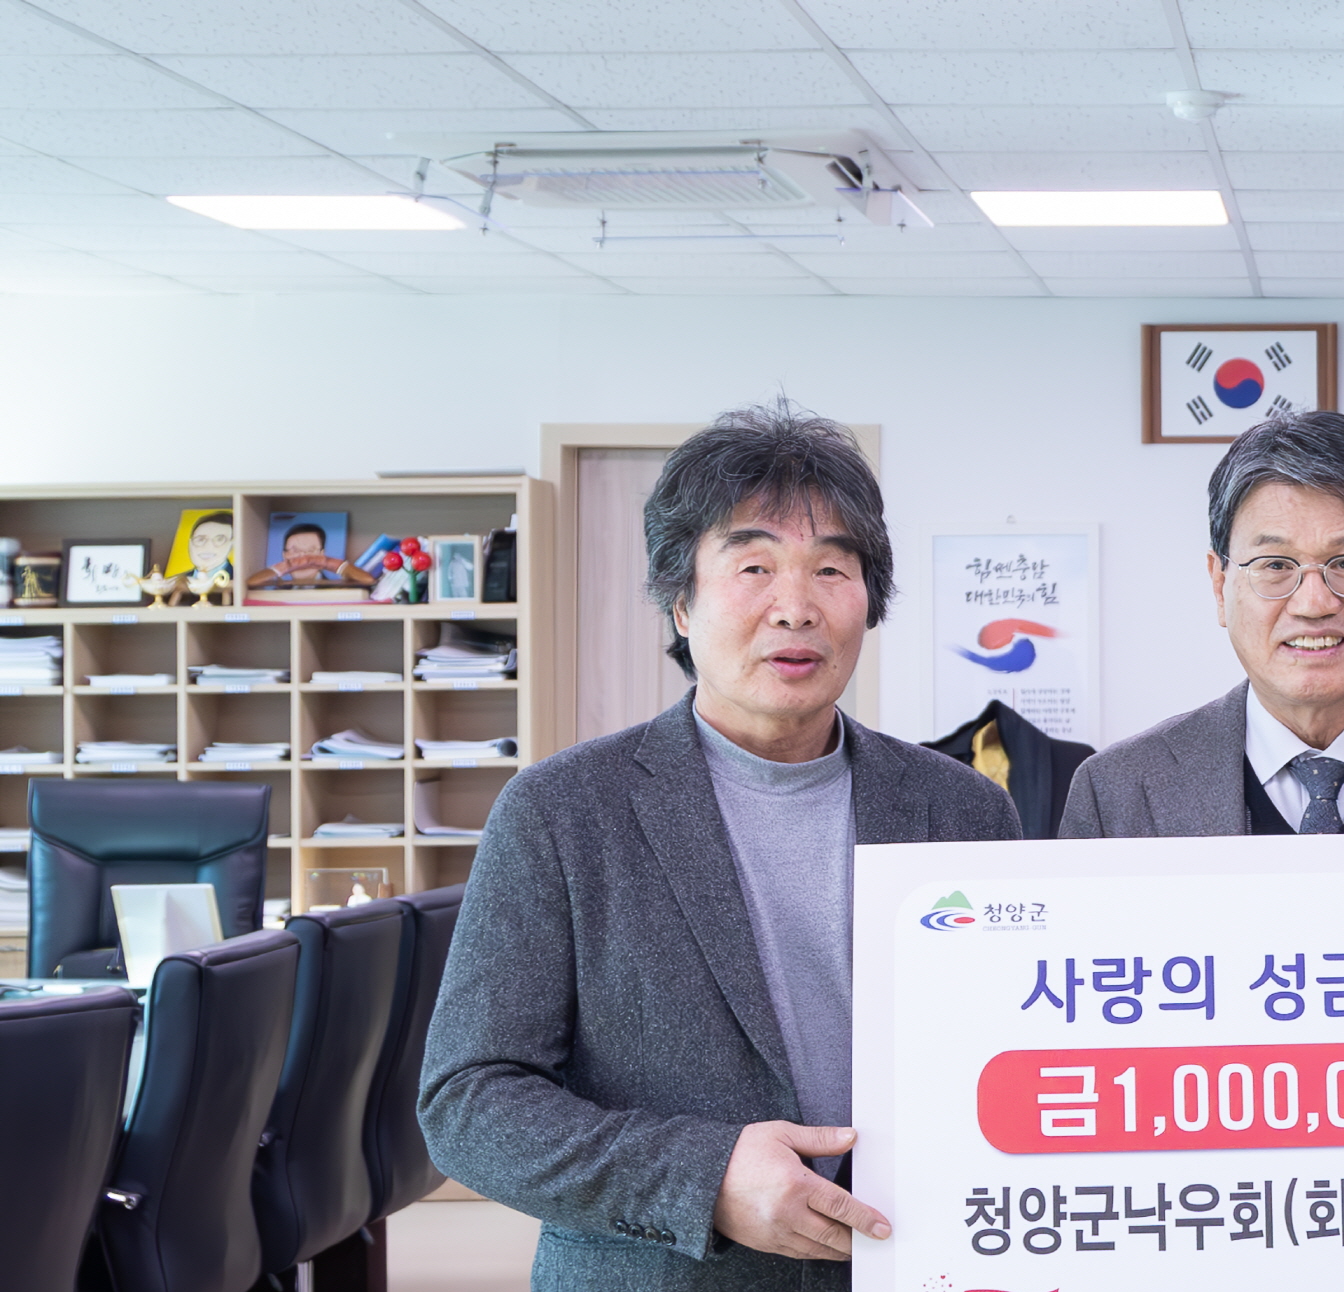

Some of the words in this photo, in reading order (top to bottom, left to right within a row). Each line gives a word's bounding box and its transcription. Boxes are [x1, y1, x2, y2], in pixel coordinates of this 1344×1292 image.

[1036, 582, 1060, 606] 힘
[983, 902, 1050, 923] 청양군
[1020, 954, 1217, 1025] 사랑의
